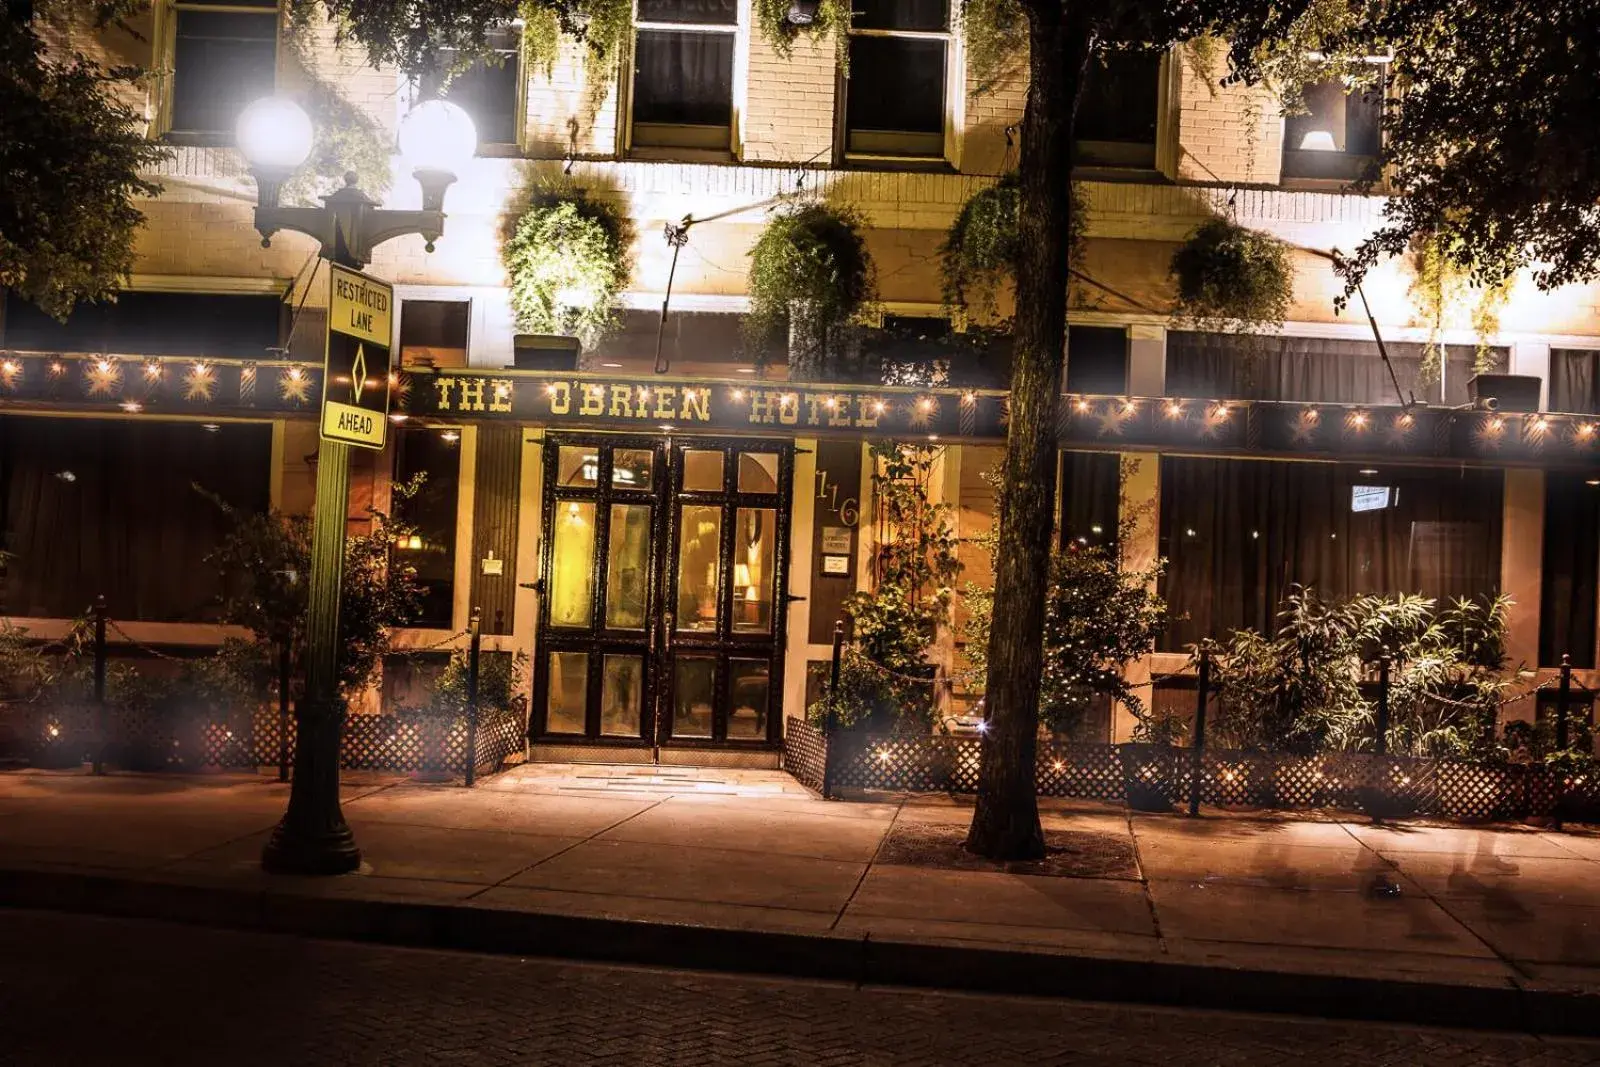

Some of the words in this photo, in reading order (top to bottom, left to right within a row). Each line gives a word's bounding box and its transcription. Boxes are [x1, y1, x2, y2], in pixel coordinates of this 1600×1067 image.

[337, 278, 387, 312] RESTRICTED
[350, 310, 373, 333] LANE
[435, 377, 513, 412] THE
[550, 380, 711, 421] O'BRIEN
[749, 389, 878, 427] HOTEL
[337, 411, 372, 435] AHEAD
[815, 470, 859, 527] 116
